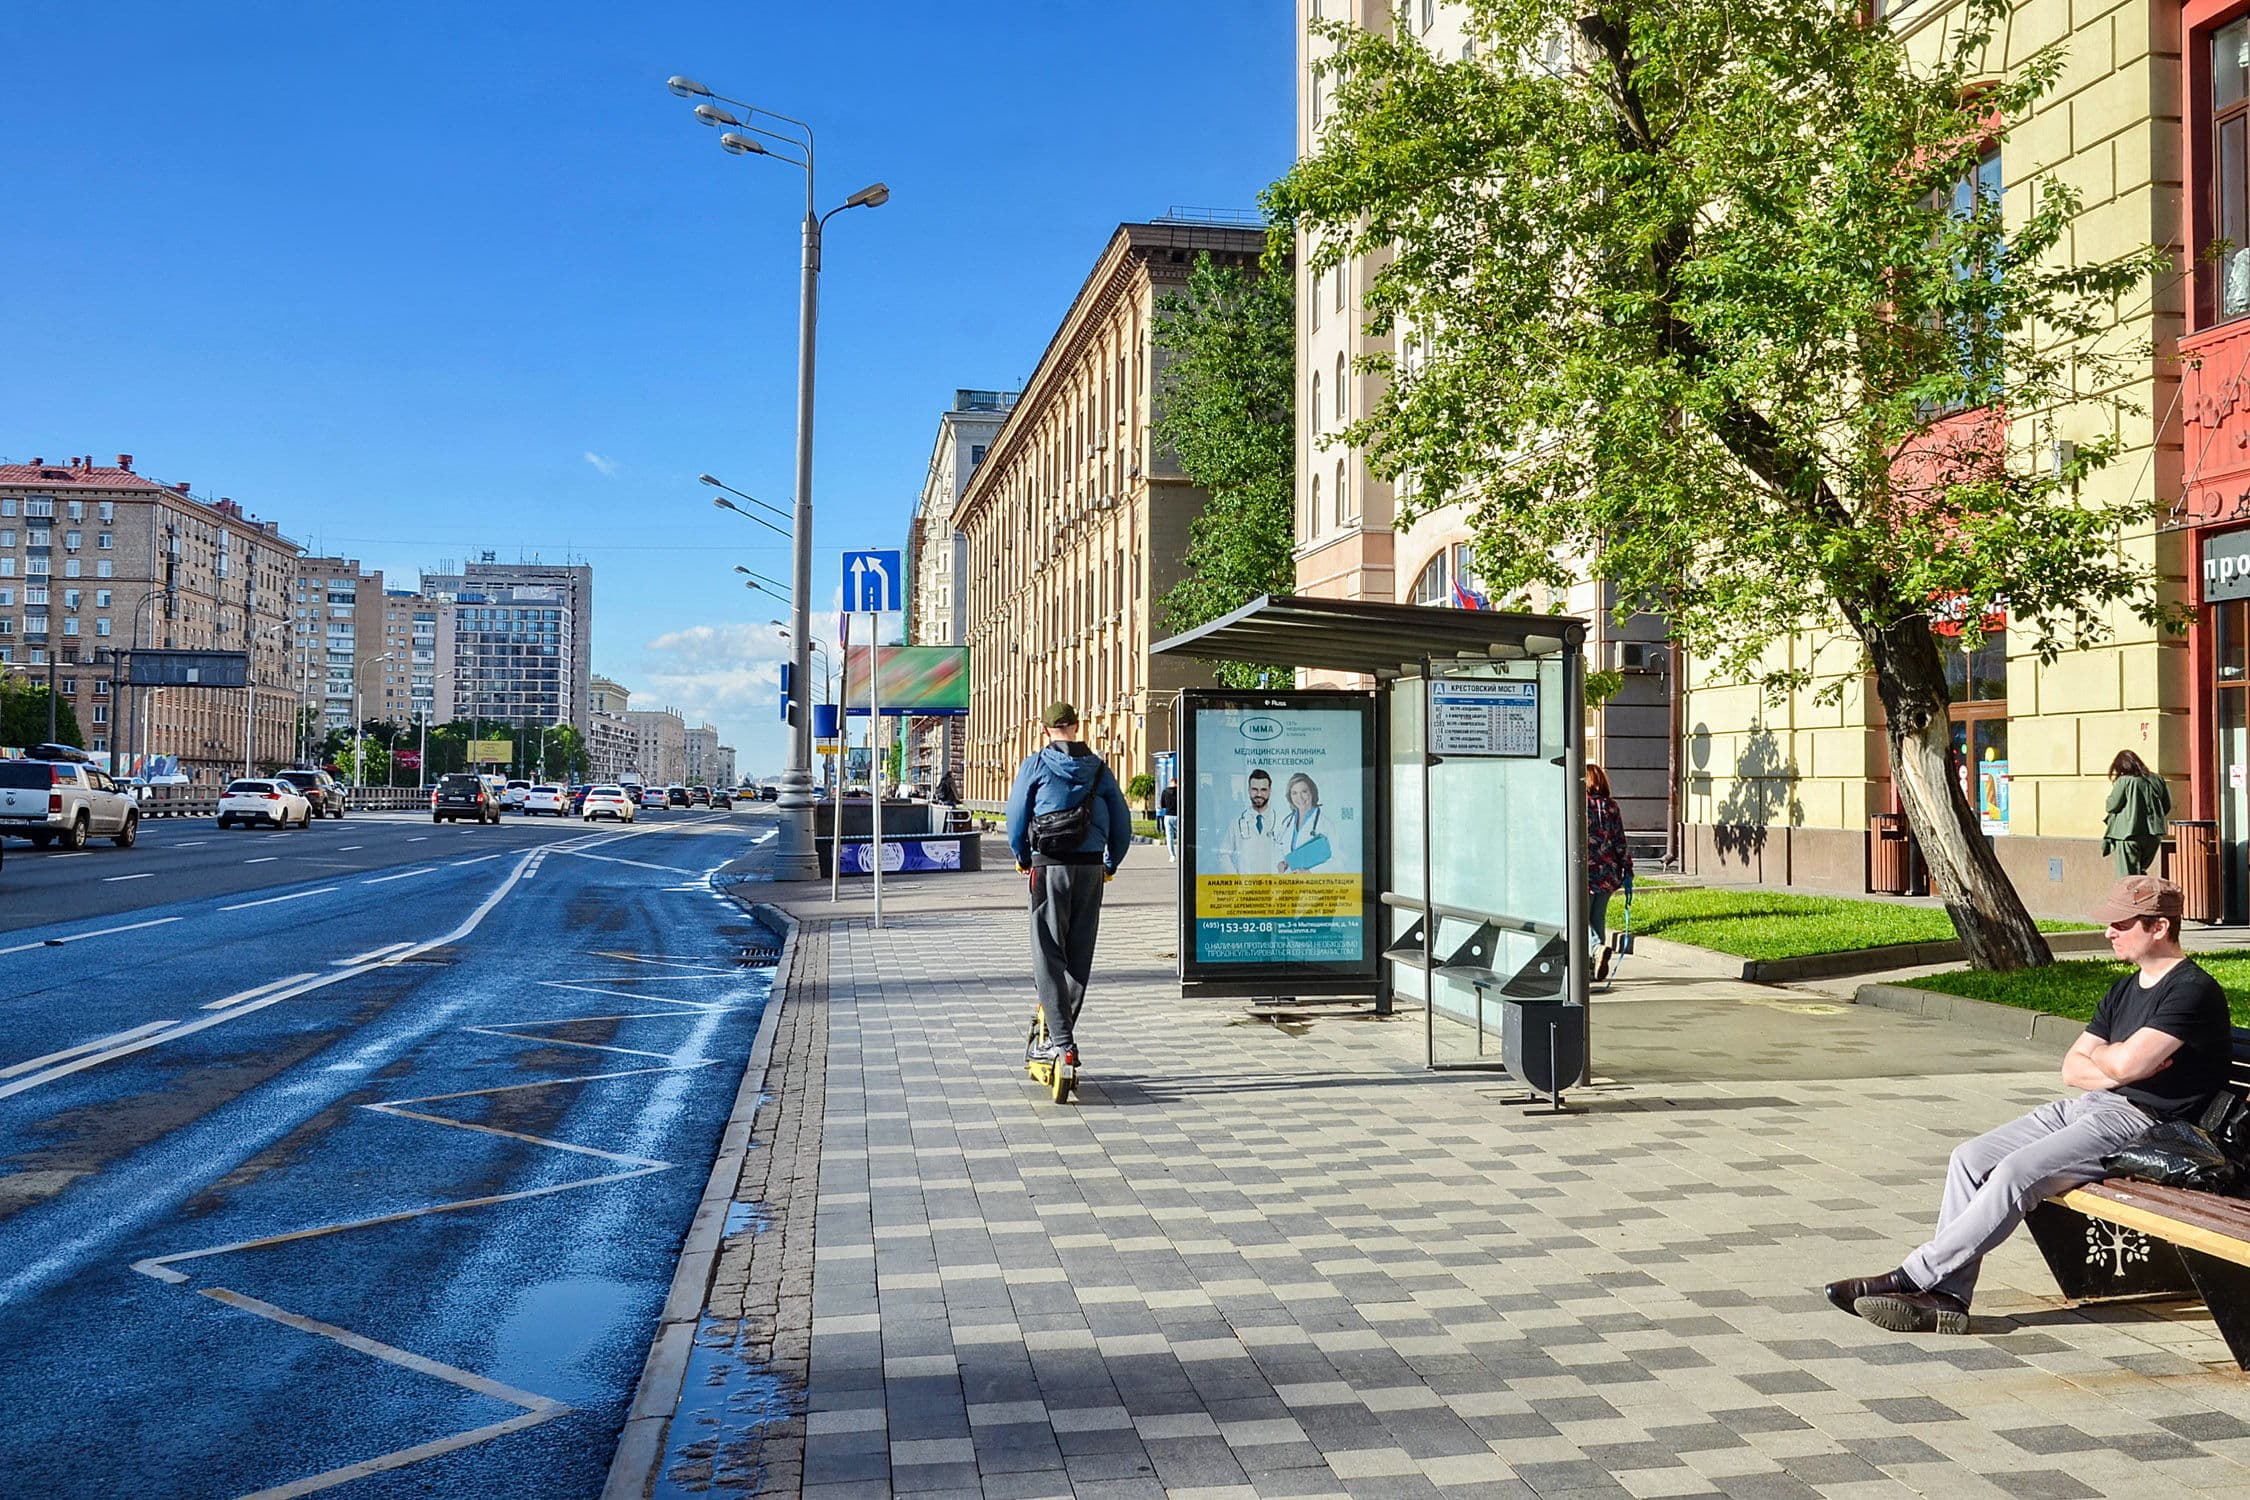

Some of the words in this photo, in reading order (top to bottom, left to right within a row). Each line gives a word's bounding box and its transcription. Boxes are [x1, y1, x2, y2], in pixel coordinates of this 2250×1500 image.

[1451, 684, 1496, 693] КРЕСТОВСКИЙ
[1498, 685, 1516, 693] МОСТ
[1525, 685, 1534, 696] А
[1250, 725, 1274, 734] IMMA
[1234, 747, 1290, 757] МЕДИЦИНСКАЯ
[1291, 748, 1326, 756] КЛИНИКА
[1246, 758, 1256, 766] НА
[1258, 756, 1314, 766] АЛЕКСЕЕВСКОЙ
[1202, 921, 1219, 929] (495)
[1220, 922, 1273, 933] 153-92-08
